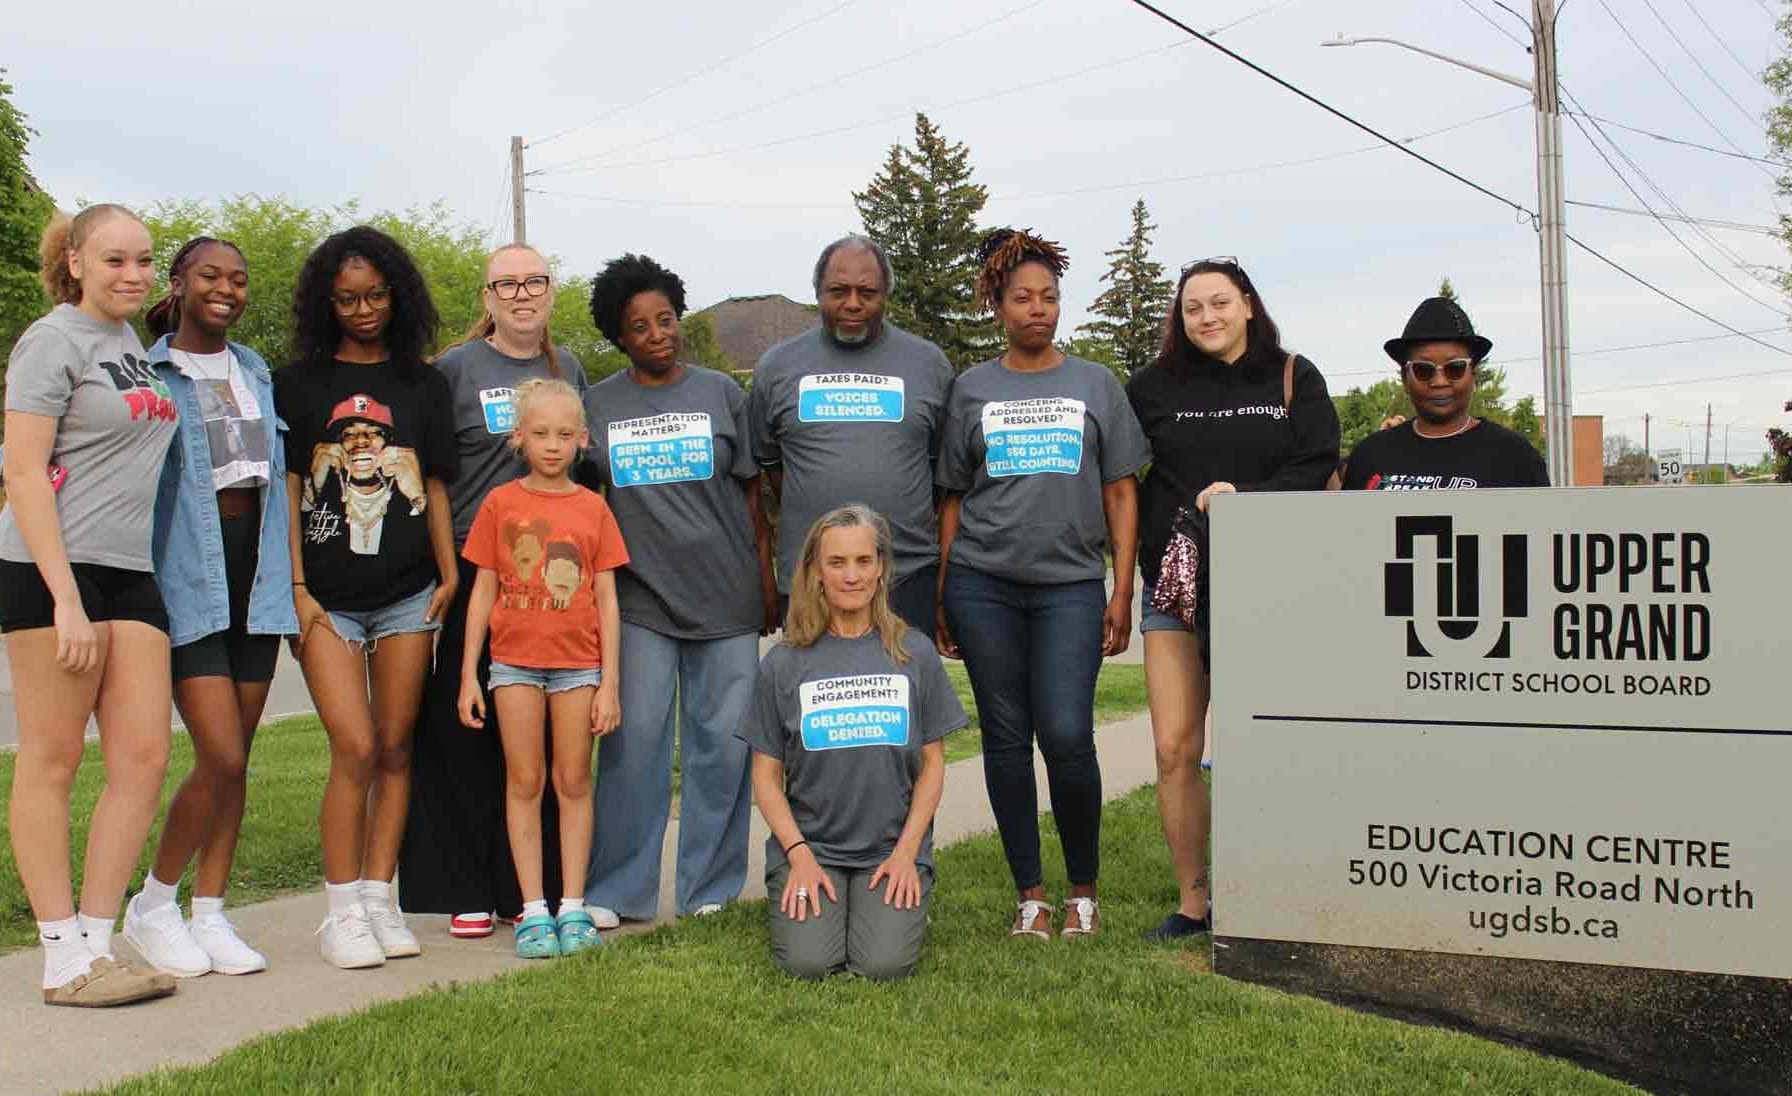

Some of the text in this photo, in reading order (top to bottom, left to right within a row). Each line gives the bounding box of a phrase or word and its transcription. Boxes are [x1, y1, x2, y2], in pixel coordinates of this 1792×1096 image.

[815, 374, 889, 385] TAXES PAID?
[123, 388, 177, 422] PROU
[824, 391, 879, 403] VOICES
[1003, 399, 1064, 408] CONCERNS
[814, 404, 887, 417] SILENCED.
[989, 406, 1078, 417] ADDRESSED AND
[1175, 405, 1289, 422] you are enough
[609, 413, 708, 431] REPRESENTATION
[1003, 414, 1064, 425] RESOLVED?
[631, 423, 688, 437] MATTERS?
[616, 438, 708, 457] BEEN IN THE
[987, 436, 1004, 447] NO
[615, 450, 710, 469] VP POOL FOR
[987, 460, 1017, 472] STILL
[632, 466, 695, 481] 3 YEARS.
[1660, 462, 1680, 477] 50
[1389, 474, 1435, 483] STAND
[1552, 532, 1711, 594] UPPER
[1552, 603, 1711, 661] GRAND
[816, 676, 892, 691] COMMUNITY
[1406, 671, 1711, 696] DISTRICT SCHOOL BOARD
[811, 688, 899, 705] ENGAGEMENT?
[810, 710, 900, 729] DELEGATION
[828, 724, 888, 742] DENIED.
[1367, 824, 1731, 868] EDUCATION CENTRE
[1348, 860, 1754, 909] 500 Victoria Road North
[1468, 905, 1619, 938] ugdsb.ca
